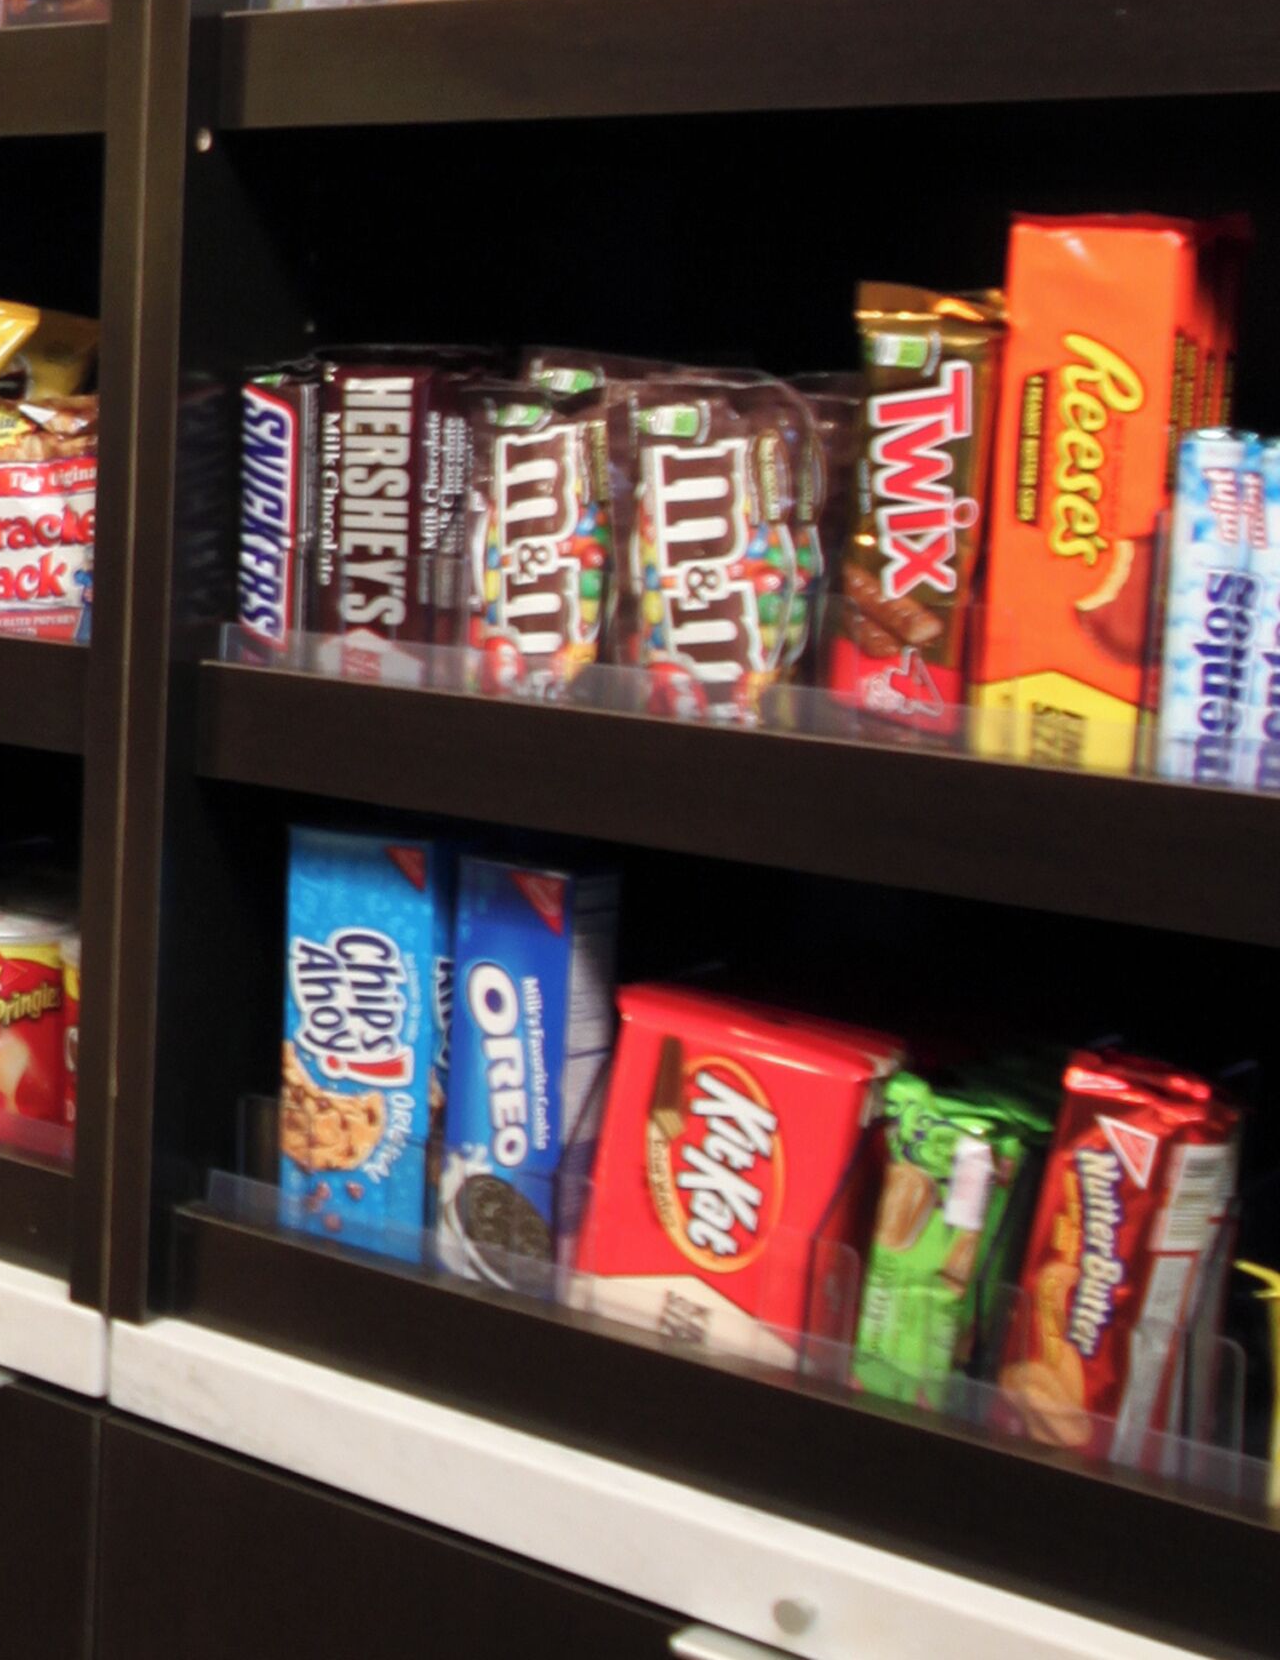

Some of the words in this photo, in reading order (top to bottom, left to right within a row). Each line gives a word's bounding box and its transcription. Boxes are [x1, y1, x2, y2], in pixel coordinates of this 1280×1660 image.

[318, 412, 340, 466] Milk
[422, 410, 441, 502] Chocolate
[1023, 386, 1044, 435] PEANUT
[1048, 332, 1146, 567] Reese's
[339, 376, 415, 627] HERSHEY'S
[1017, 488, 1038, 523] CUPS
[1020, 437, 1041, 486] BUTTER
[1201, 466, 1241, 544] mint
[241, 393, 288, 641] SNICKERS
[317, 468, 340, 586] Chocolate
[421, 504, 441, 551] Milk
[1190, 570, 1256, 783] mentos
[330, 930, 407, 1056] Chips
[521, 977, 541, 1028] Milk's
[467, 962, 530, 1169] OREO
[529, 1030, 547, 1095] Favorite
[533, 1095, 552, 1151] Cookie
[689, 1071, 778, 1172] Kit
[676, 1143, 763, 1257] Kat
